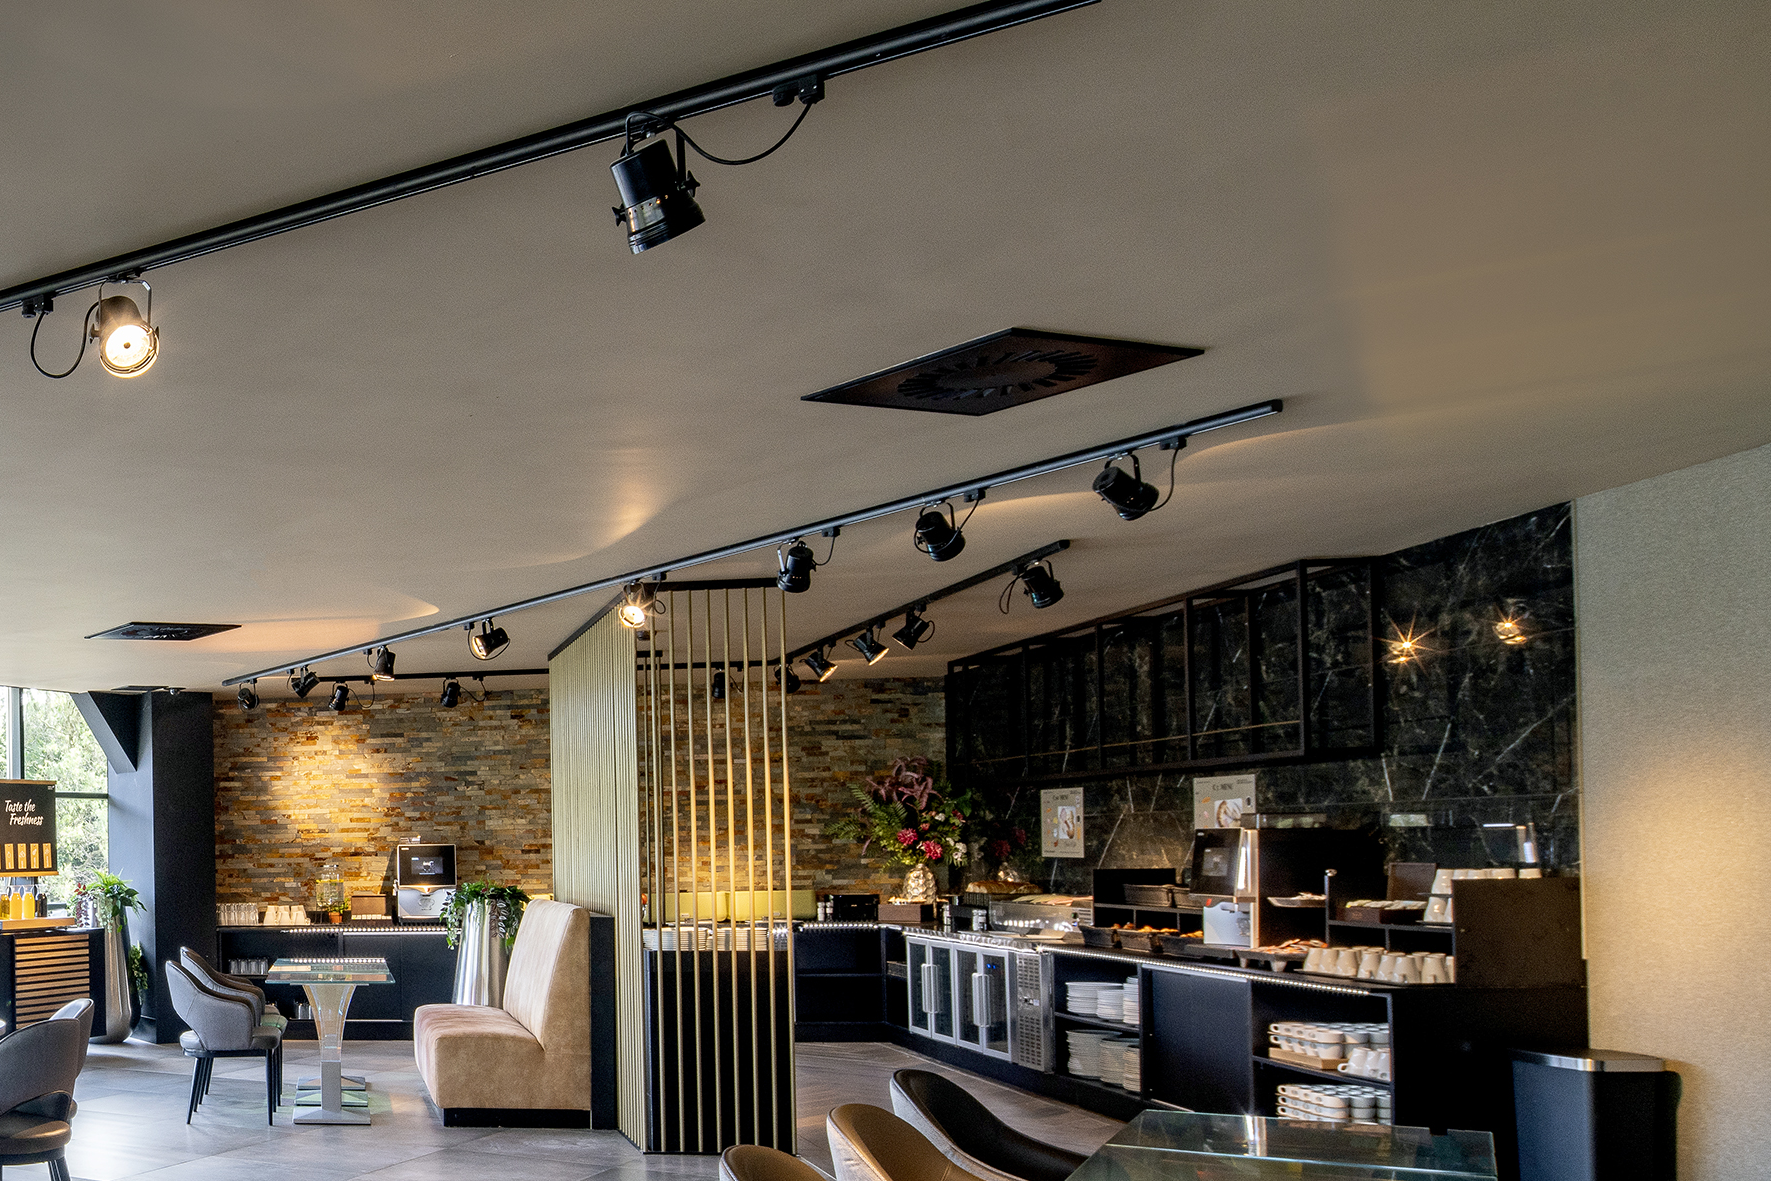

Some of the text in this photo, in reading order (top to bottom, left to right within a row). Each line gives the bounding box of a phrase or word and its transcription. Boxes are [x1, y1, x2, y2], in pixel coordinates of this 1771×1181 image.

[5, 799, 36, 812] Taste the
[9, 812, 44, 826] Freshness
